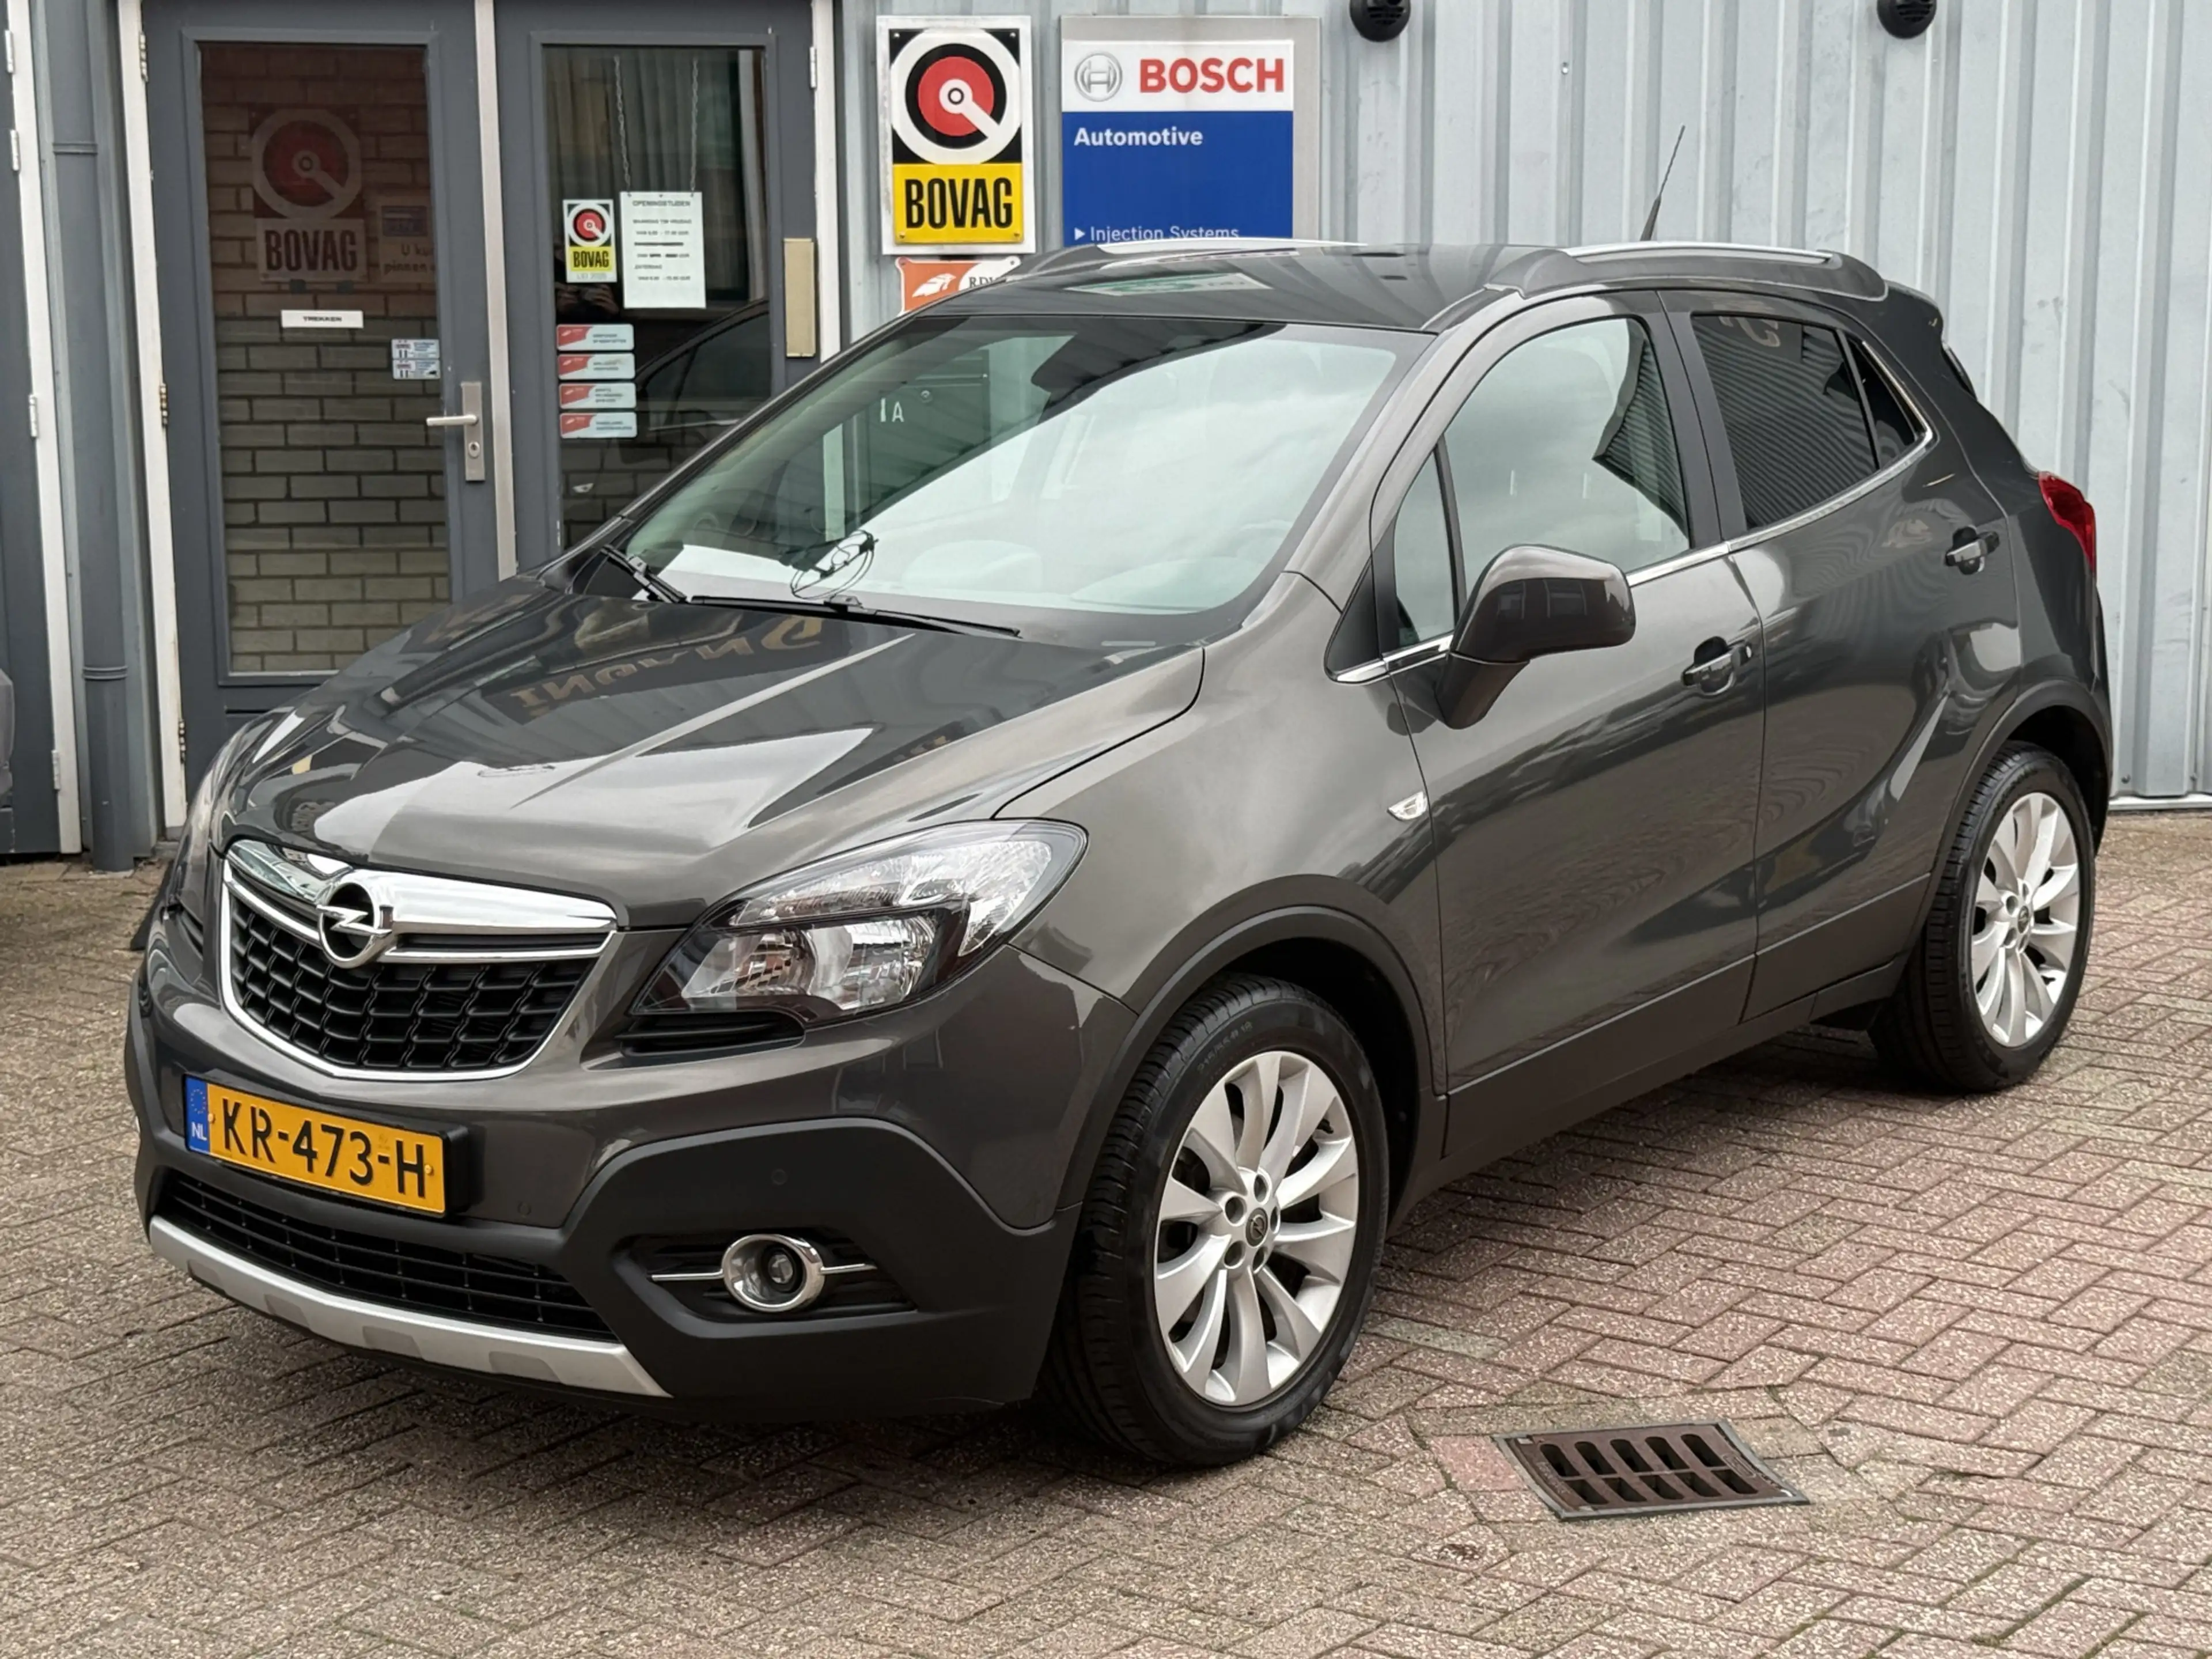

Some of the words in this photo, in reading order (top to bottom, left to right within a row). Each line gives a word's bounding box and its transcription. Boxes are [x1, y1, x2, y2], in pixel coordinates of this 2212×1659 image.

[1139, 57, 1285, 93] BOSCH
[1074, 126, 1203, 147] Automotive
[904, 177, 1013, 229] BOVAG
[1090, 226, 1164, 243] Injection
[264, 229, 358, 271] BOVAG
[573, 251, 609, 268] BOVAG
[191, 1122, 207, 1142] NL
[222, 1097, 426, 1198] KR-473-H
